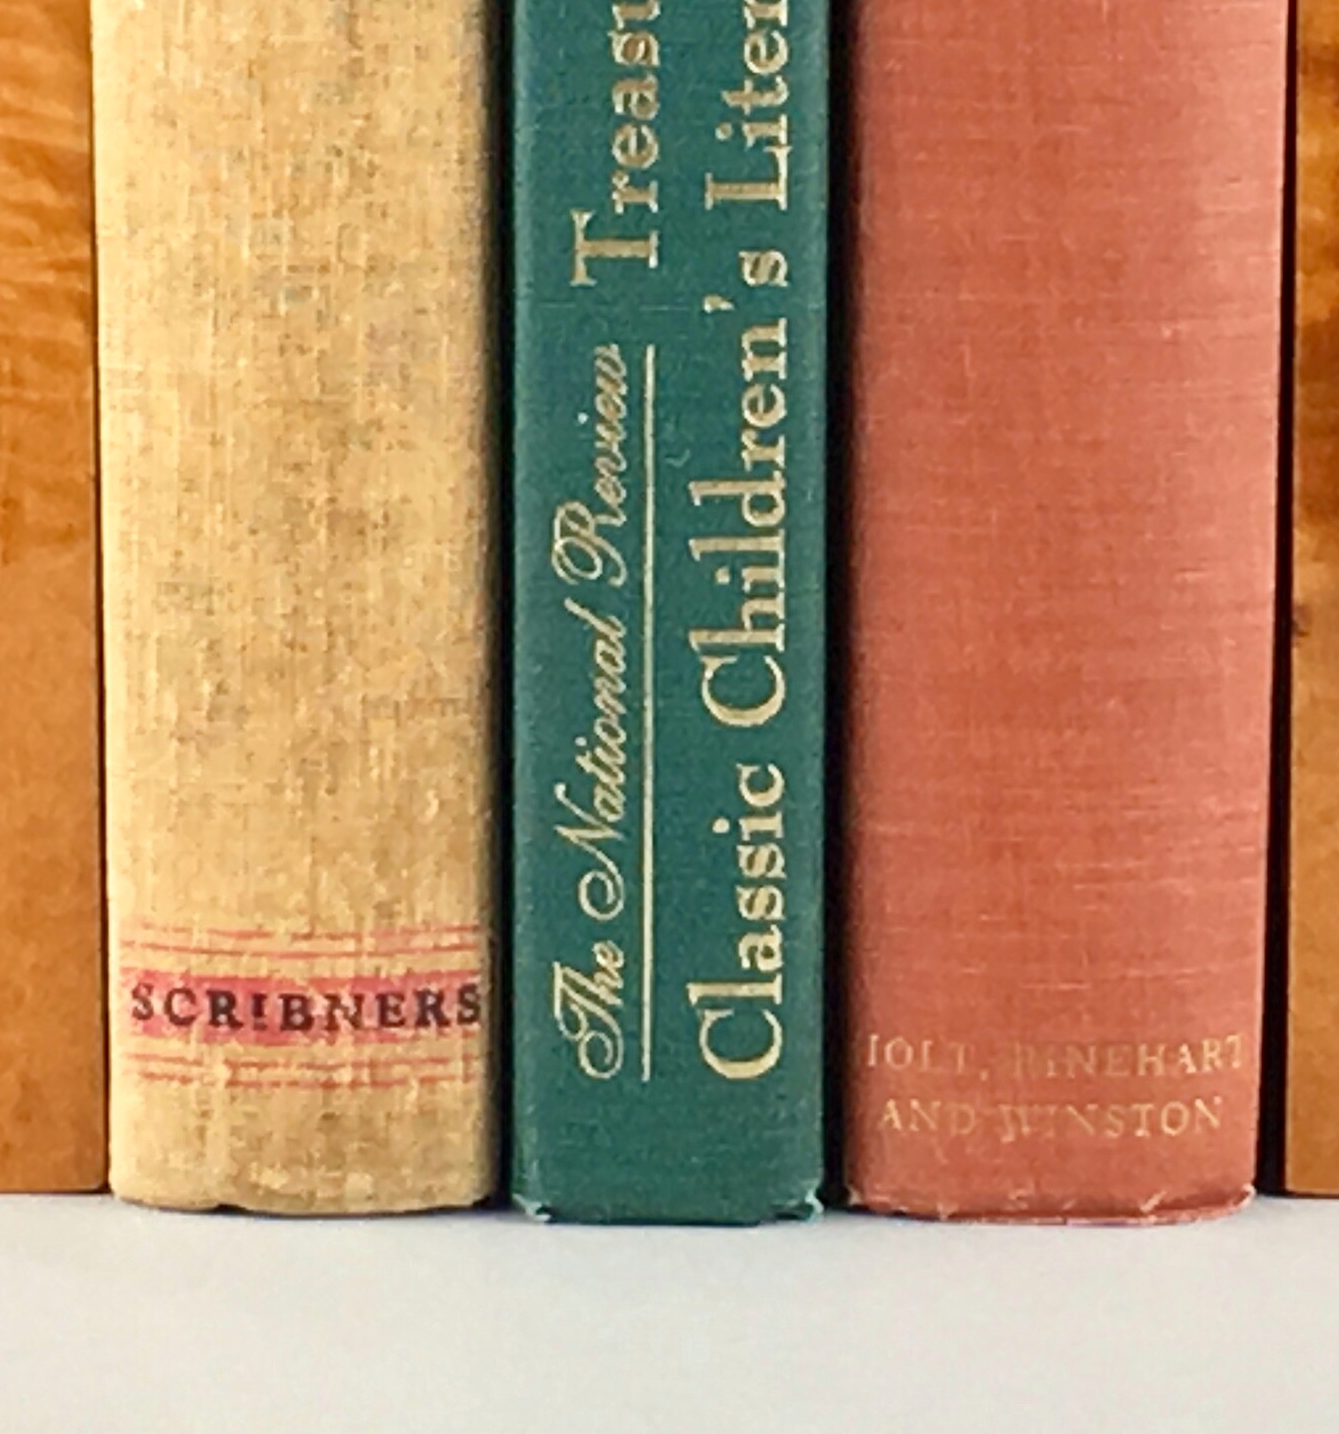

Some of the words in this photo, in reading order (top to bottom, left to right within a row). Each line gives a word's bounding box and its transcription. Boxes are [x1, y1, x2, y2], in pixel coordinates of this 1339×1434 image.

[552, 343, 629, 588] Review
[688, 249, 790, 729] Children's
[554, 597, 627, 923] National
[130, 982, 482, 1033] SCRIBNERS
[553, 940, 625, 1081] The
[688, 762, 784, 1081] Classic
[879, 1097, 979, 1137] AND
